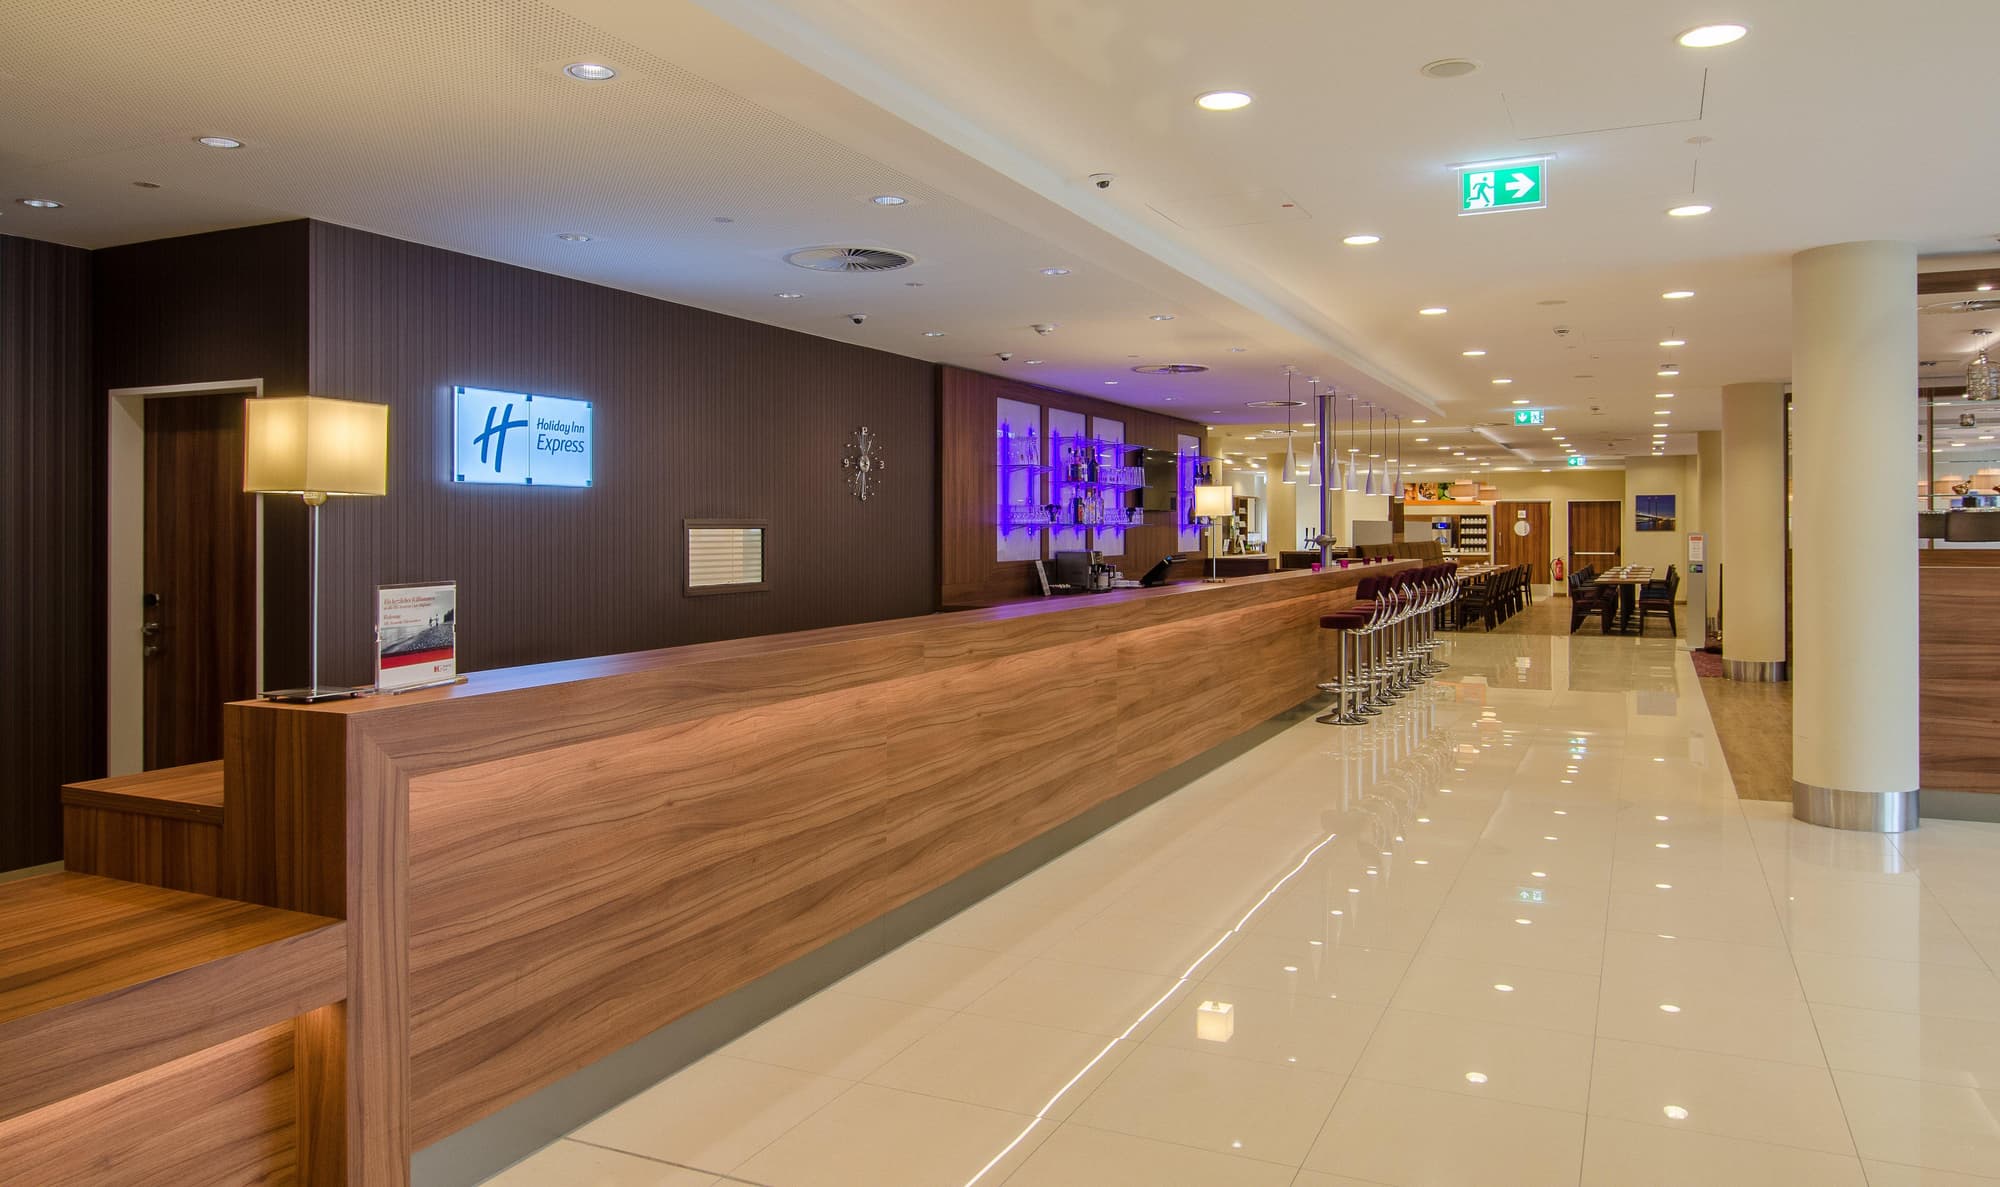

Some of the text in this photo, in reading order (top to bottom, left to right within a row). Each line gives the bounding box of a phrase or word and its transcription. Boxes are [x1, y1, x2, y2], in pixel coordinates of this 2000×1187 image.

[537, 418, 584, 435] Holiday Inn
[473, 403, 528, 472] H
[537, 434, 584, 455] Express
[844, 459, 850, 468] 9
[879, 460, 885, 469] 3
